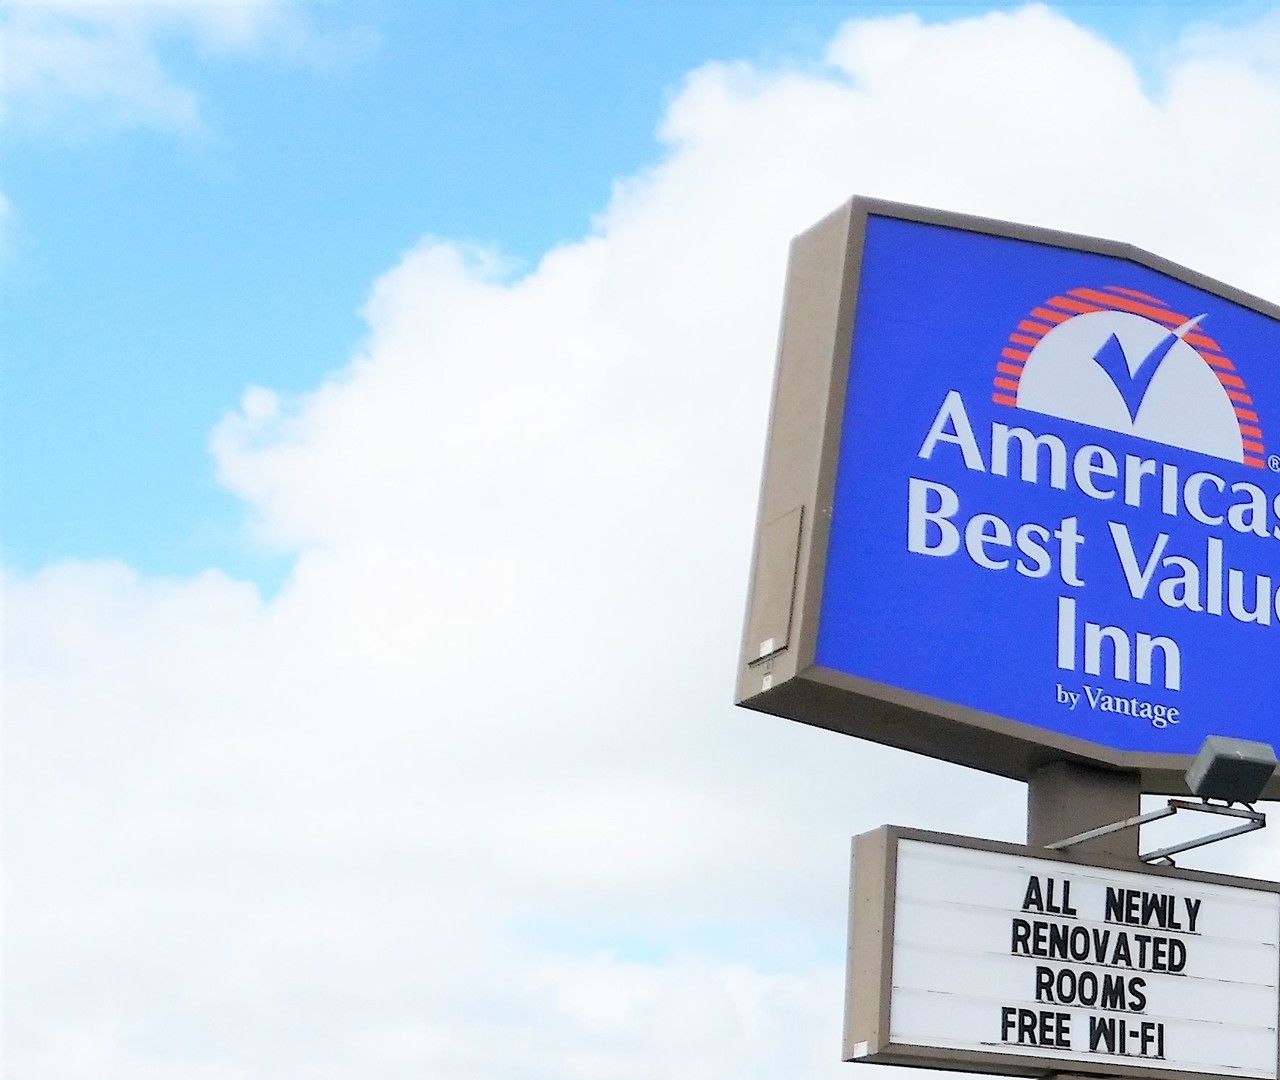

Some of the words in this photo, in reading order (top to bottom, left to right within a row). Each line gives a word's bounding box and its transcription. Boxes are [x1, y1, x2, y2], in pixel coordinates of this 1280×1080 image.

[907, 477, 1085, 587] Best
[1056, 596, 1182, 691] Inn
[1056, 683, 1080, 712] by
[1082, 685, 1181, 729] Vantage
[1022, 875, 1077, 916] ALL
[1104, 886, 1202, 932] NEWLY
[1011, 918, 1187, 973] RENOVATED
[1035, 965, 1147, 1012] ROOMS
[1001, 1006, 1071, 1048] FREE
[1088, 1015, 1166, 1058] WI-FI
